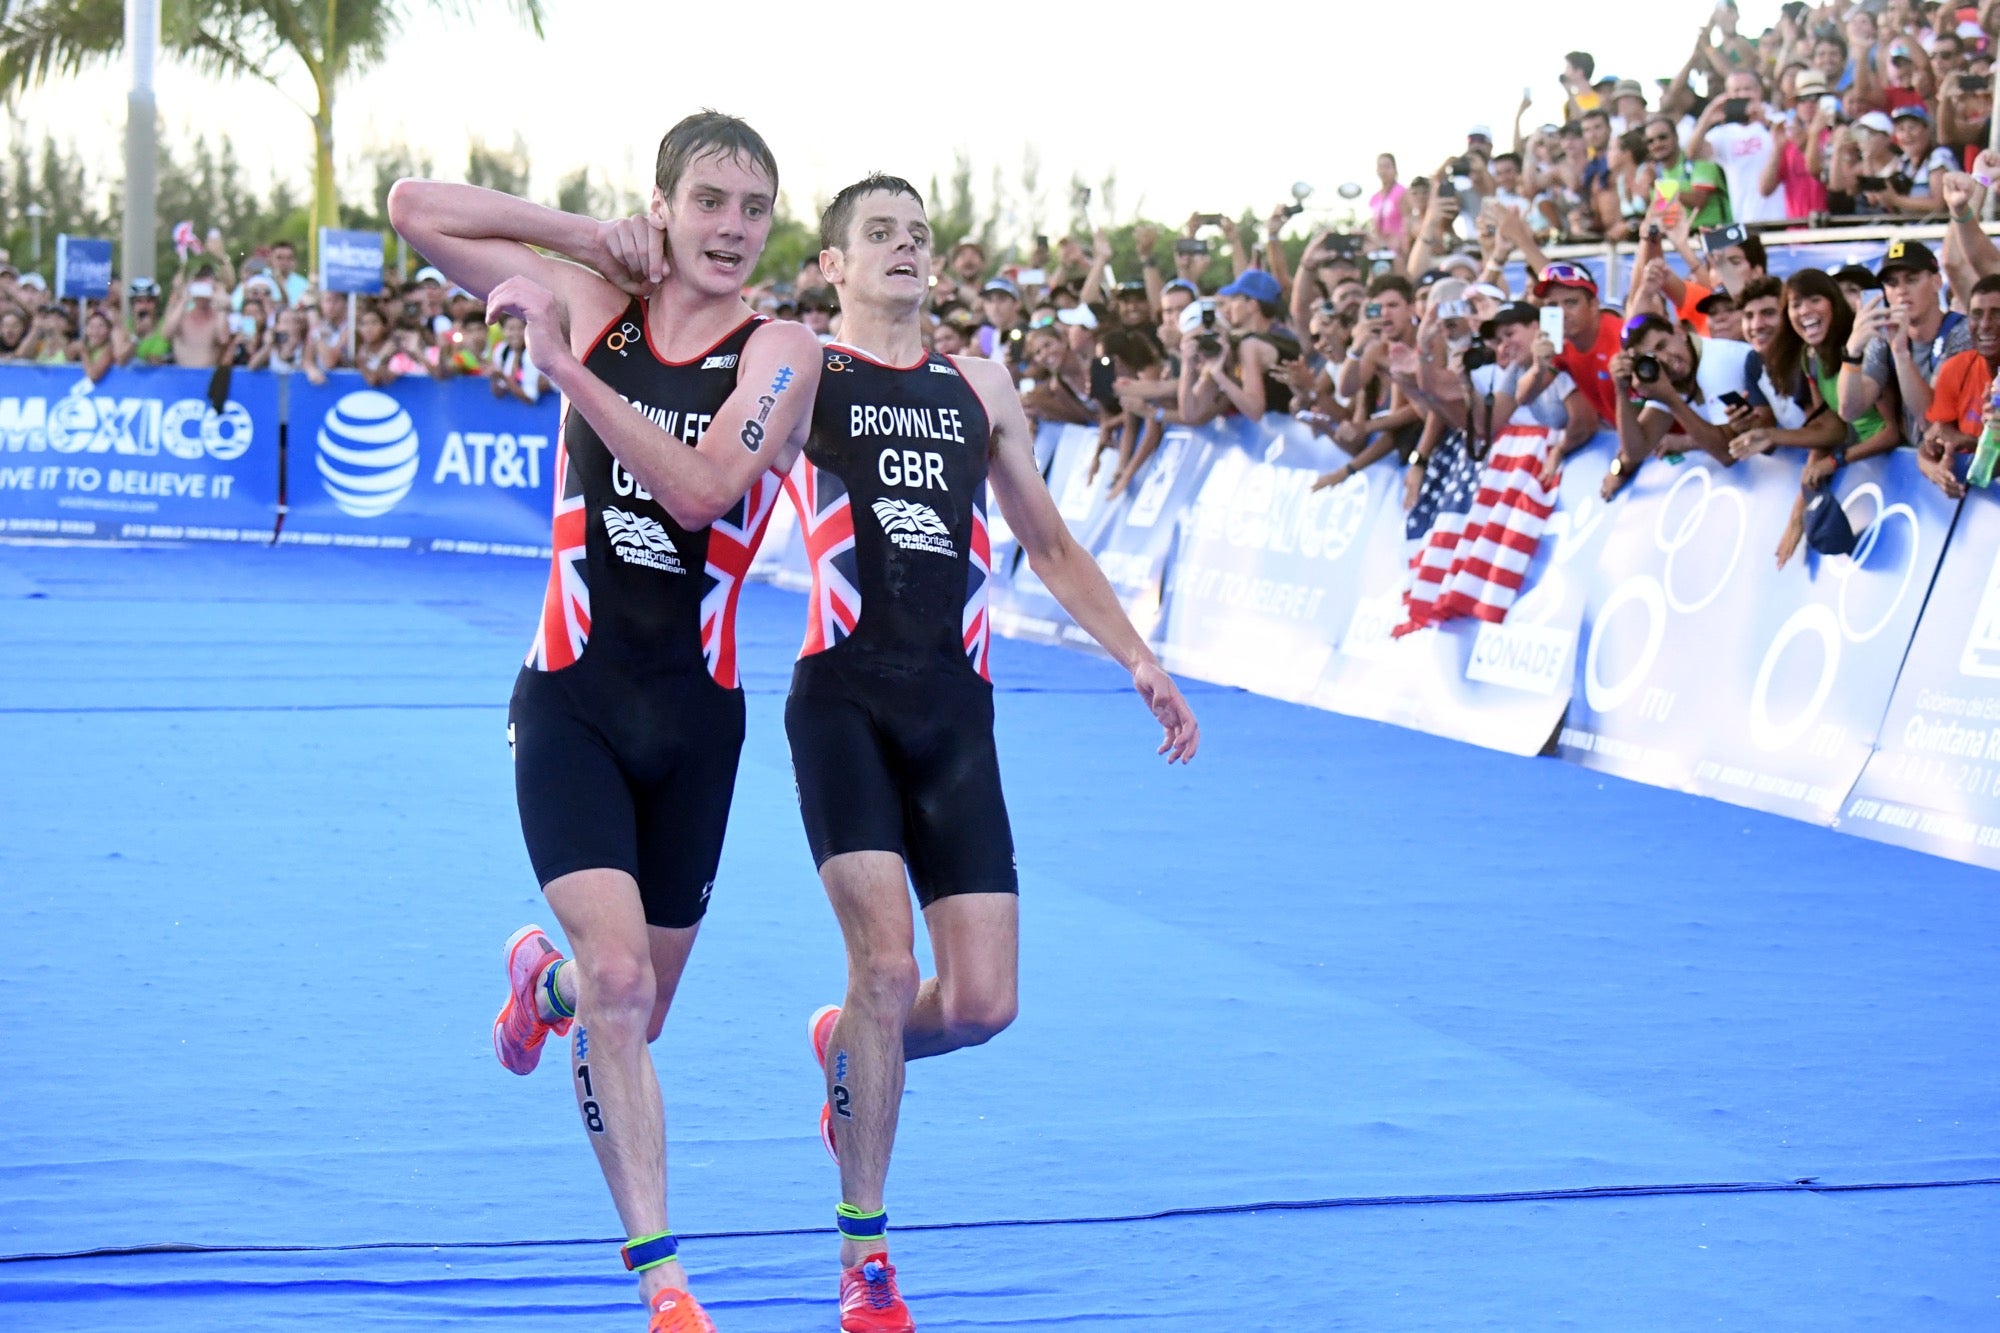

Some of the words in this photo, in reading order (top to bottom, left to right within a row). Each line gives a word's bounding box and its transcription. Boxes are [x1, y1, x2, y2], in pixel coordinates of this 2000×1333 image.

[850, 404, 965, 444] BROWNLEE
[433, 431, 549, 488] AT&T
[878, 448, 949, 491] GBR
[0, 466, 36, 490] IVE
[39, 466, 61, 490] IT
[66, 466, 102, 491] TO
[107, 469, 207, 498] BELIEVE
[211, 475, 235, 499] IT
[577, 1063, 605, 1133] 18
[833, 1084, 852, 1118] 2
